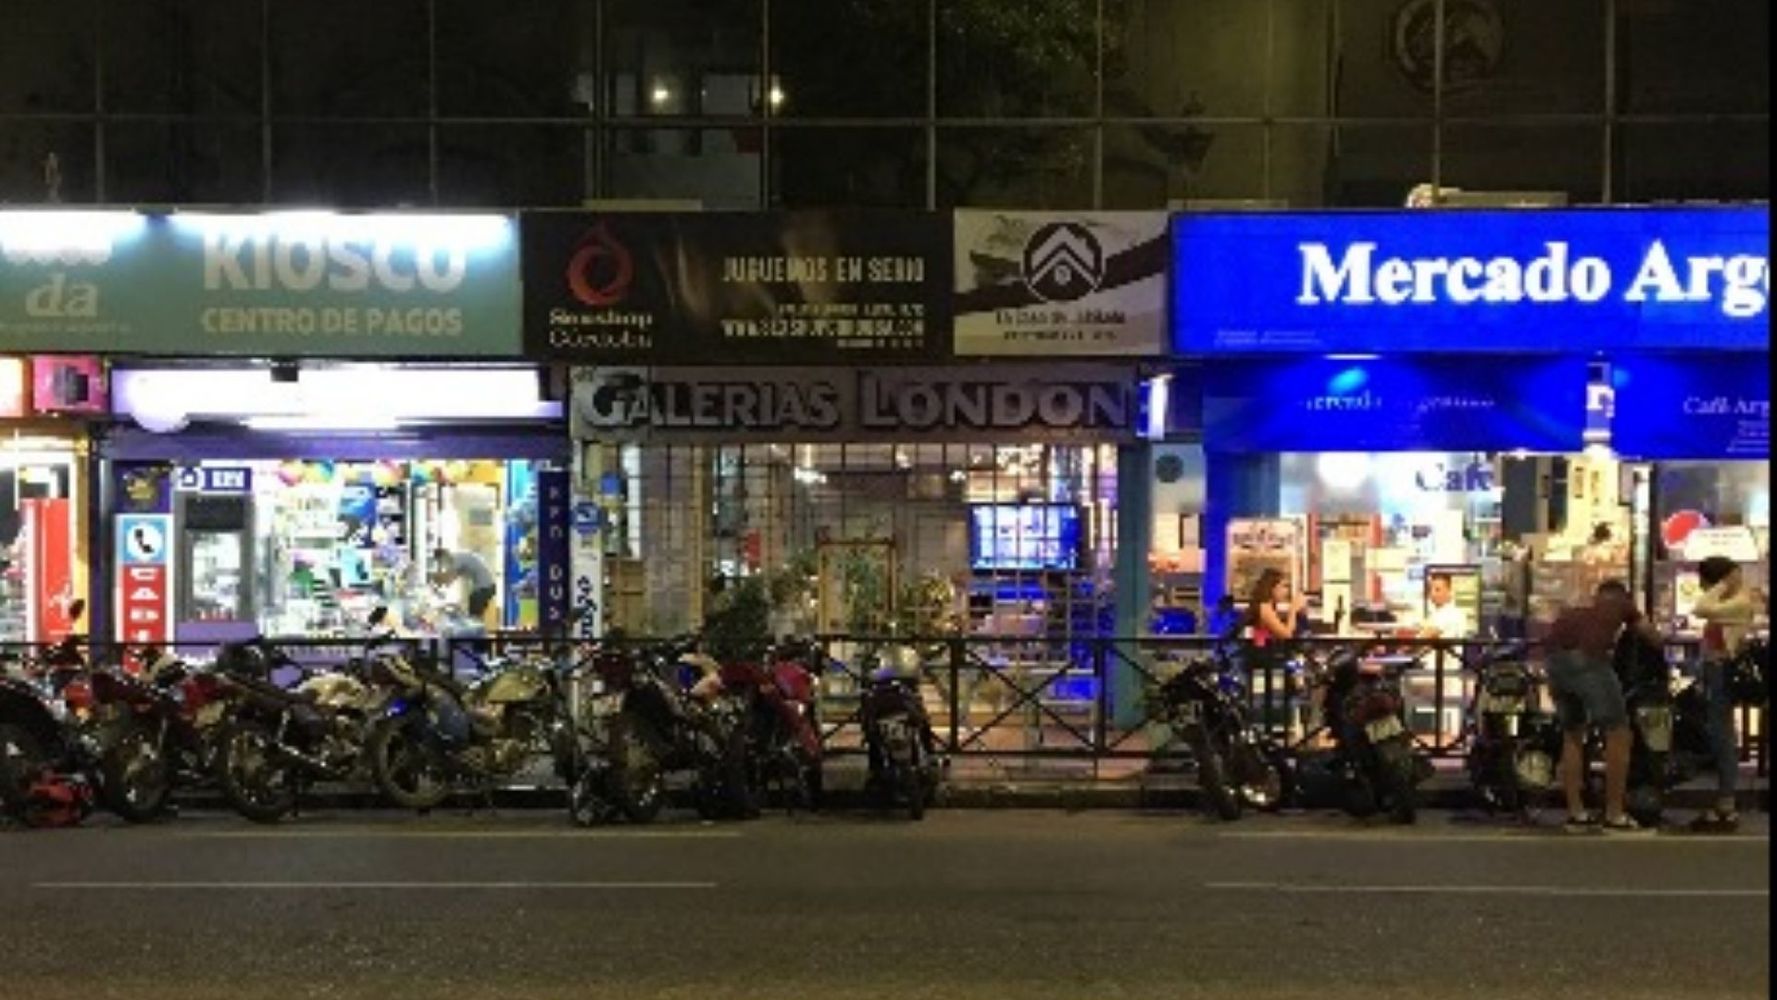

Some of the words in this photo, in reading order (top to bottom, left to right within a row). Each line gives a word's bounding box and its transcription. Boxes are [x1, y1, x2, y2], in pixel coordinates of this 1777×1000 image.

[203, 231, 467, 293] KIOSCO
[723, 256, 827, 282] JUGUEMOS
[836, 256, 862, 282] EN
[869, 256, 925, 282] SERIO
[1296, 241, 1612, 305] Mercado
[1624, 240, 1769, 317] Arg
[26, 273, 97, 318] da
[203, 308, 315, 336] CENTRO
[322, 308, 358, 335] DE
[367, 308, 464, 336] PAGOS
[585, 369, 840, 429] GALERIAS
[858, 369, 1130, 429] LONDON
